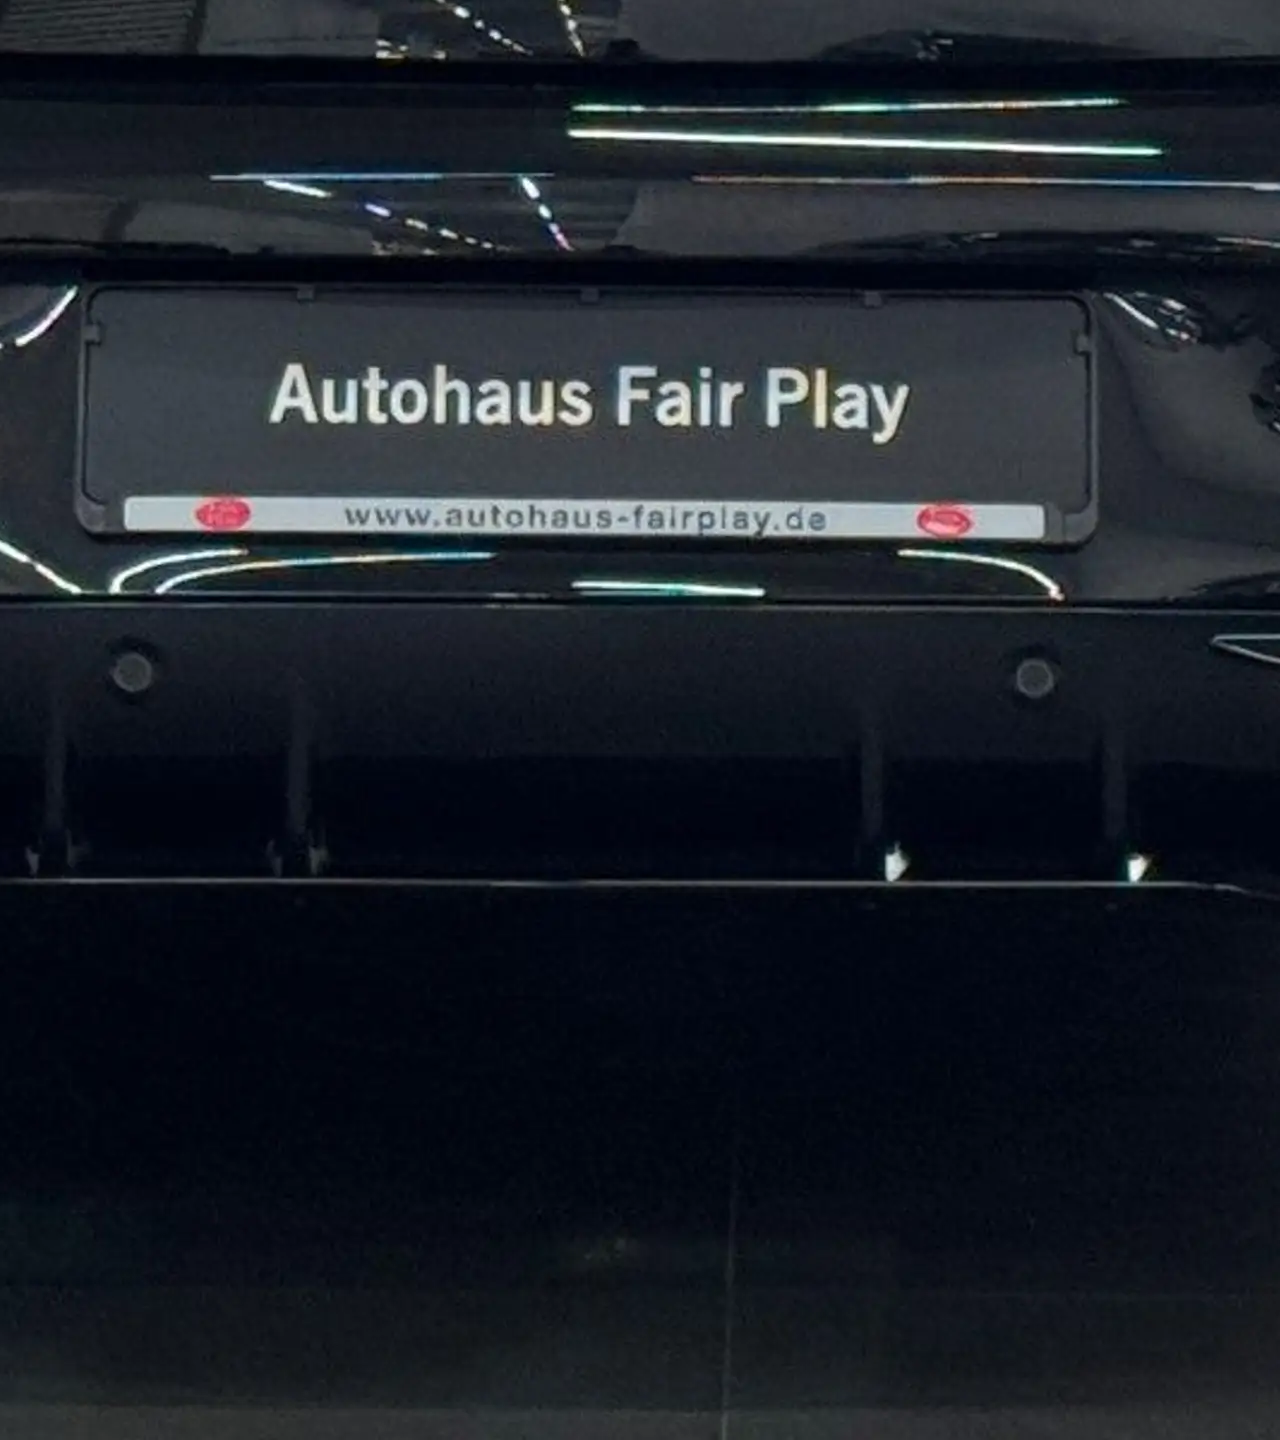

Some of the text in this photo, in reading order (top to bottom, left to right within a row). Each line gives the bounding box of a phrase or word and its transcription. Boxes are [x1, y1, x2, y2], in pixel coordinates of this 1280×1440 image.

[268, 363, 911, 446] Autohaus Fair Play
[344, 504, 828, 536] www.autohaus-fairplay.de
